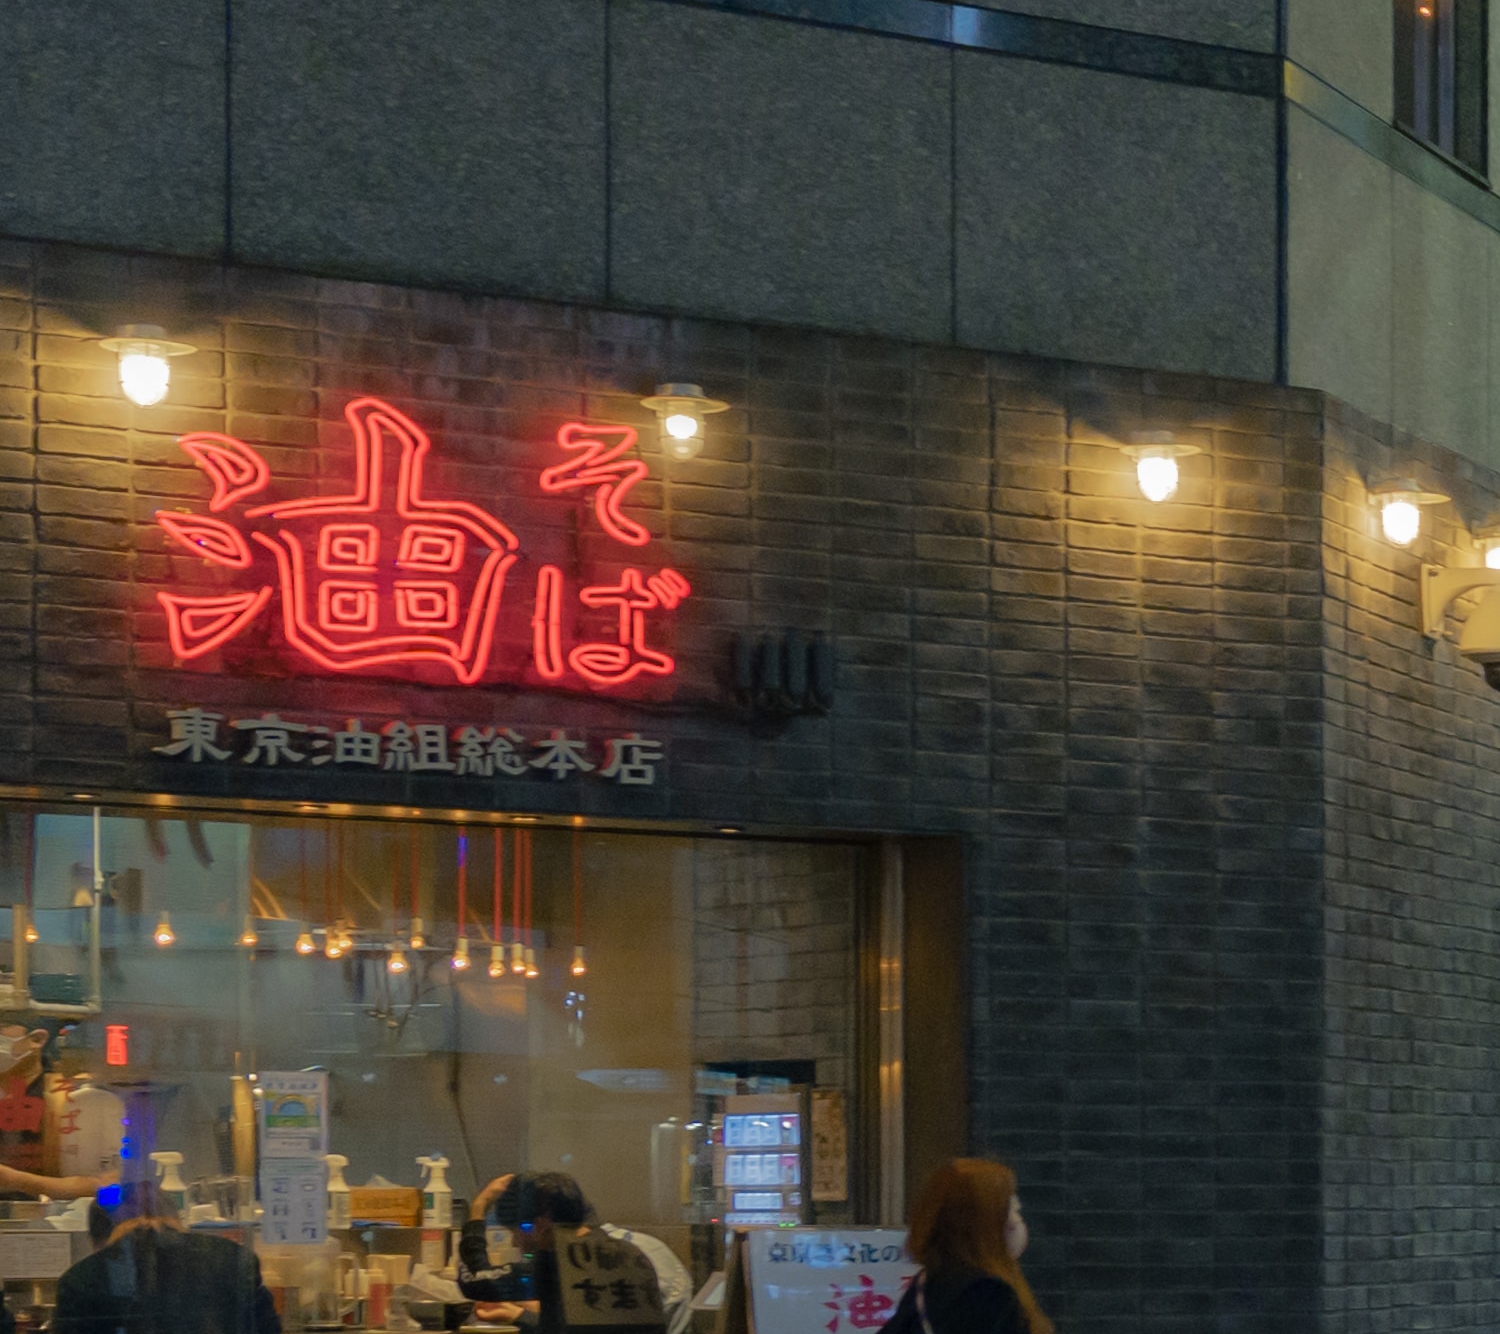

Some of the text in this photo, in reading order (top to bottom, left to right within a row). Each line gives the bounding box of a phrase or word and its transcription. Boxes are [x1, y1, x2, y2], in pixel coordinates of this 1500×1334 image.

[156, 397, 692, 685] 油そば
[154, 707, 664, 785] 東京油組総本店
[824, 1273, 915, 1334] 油
